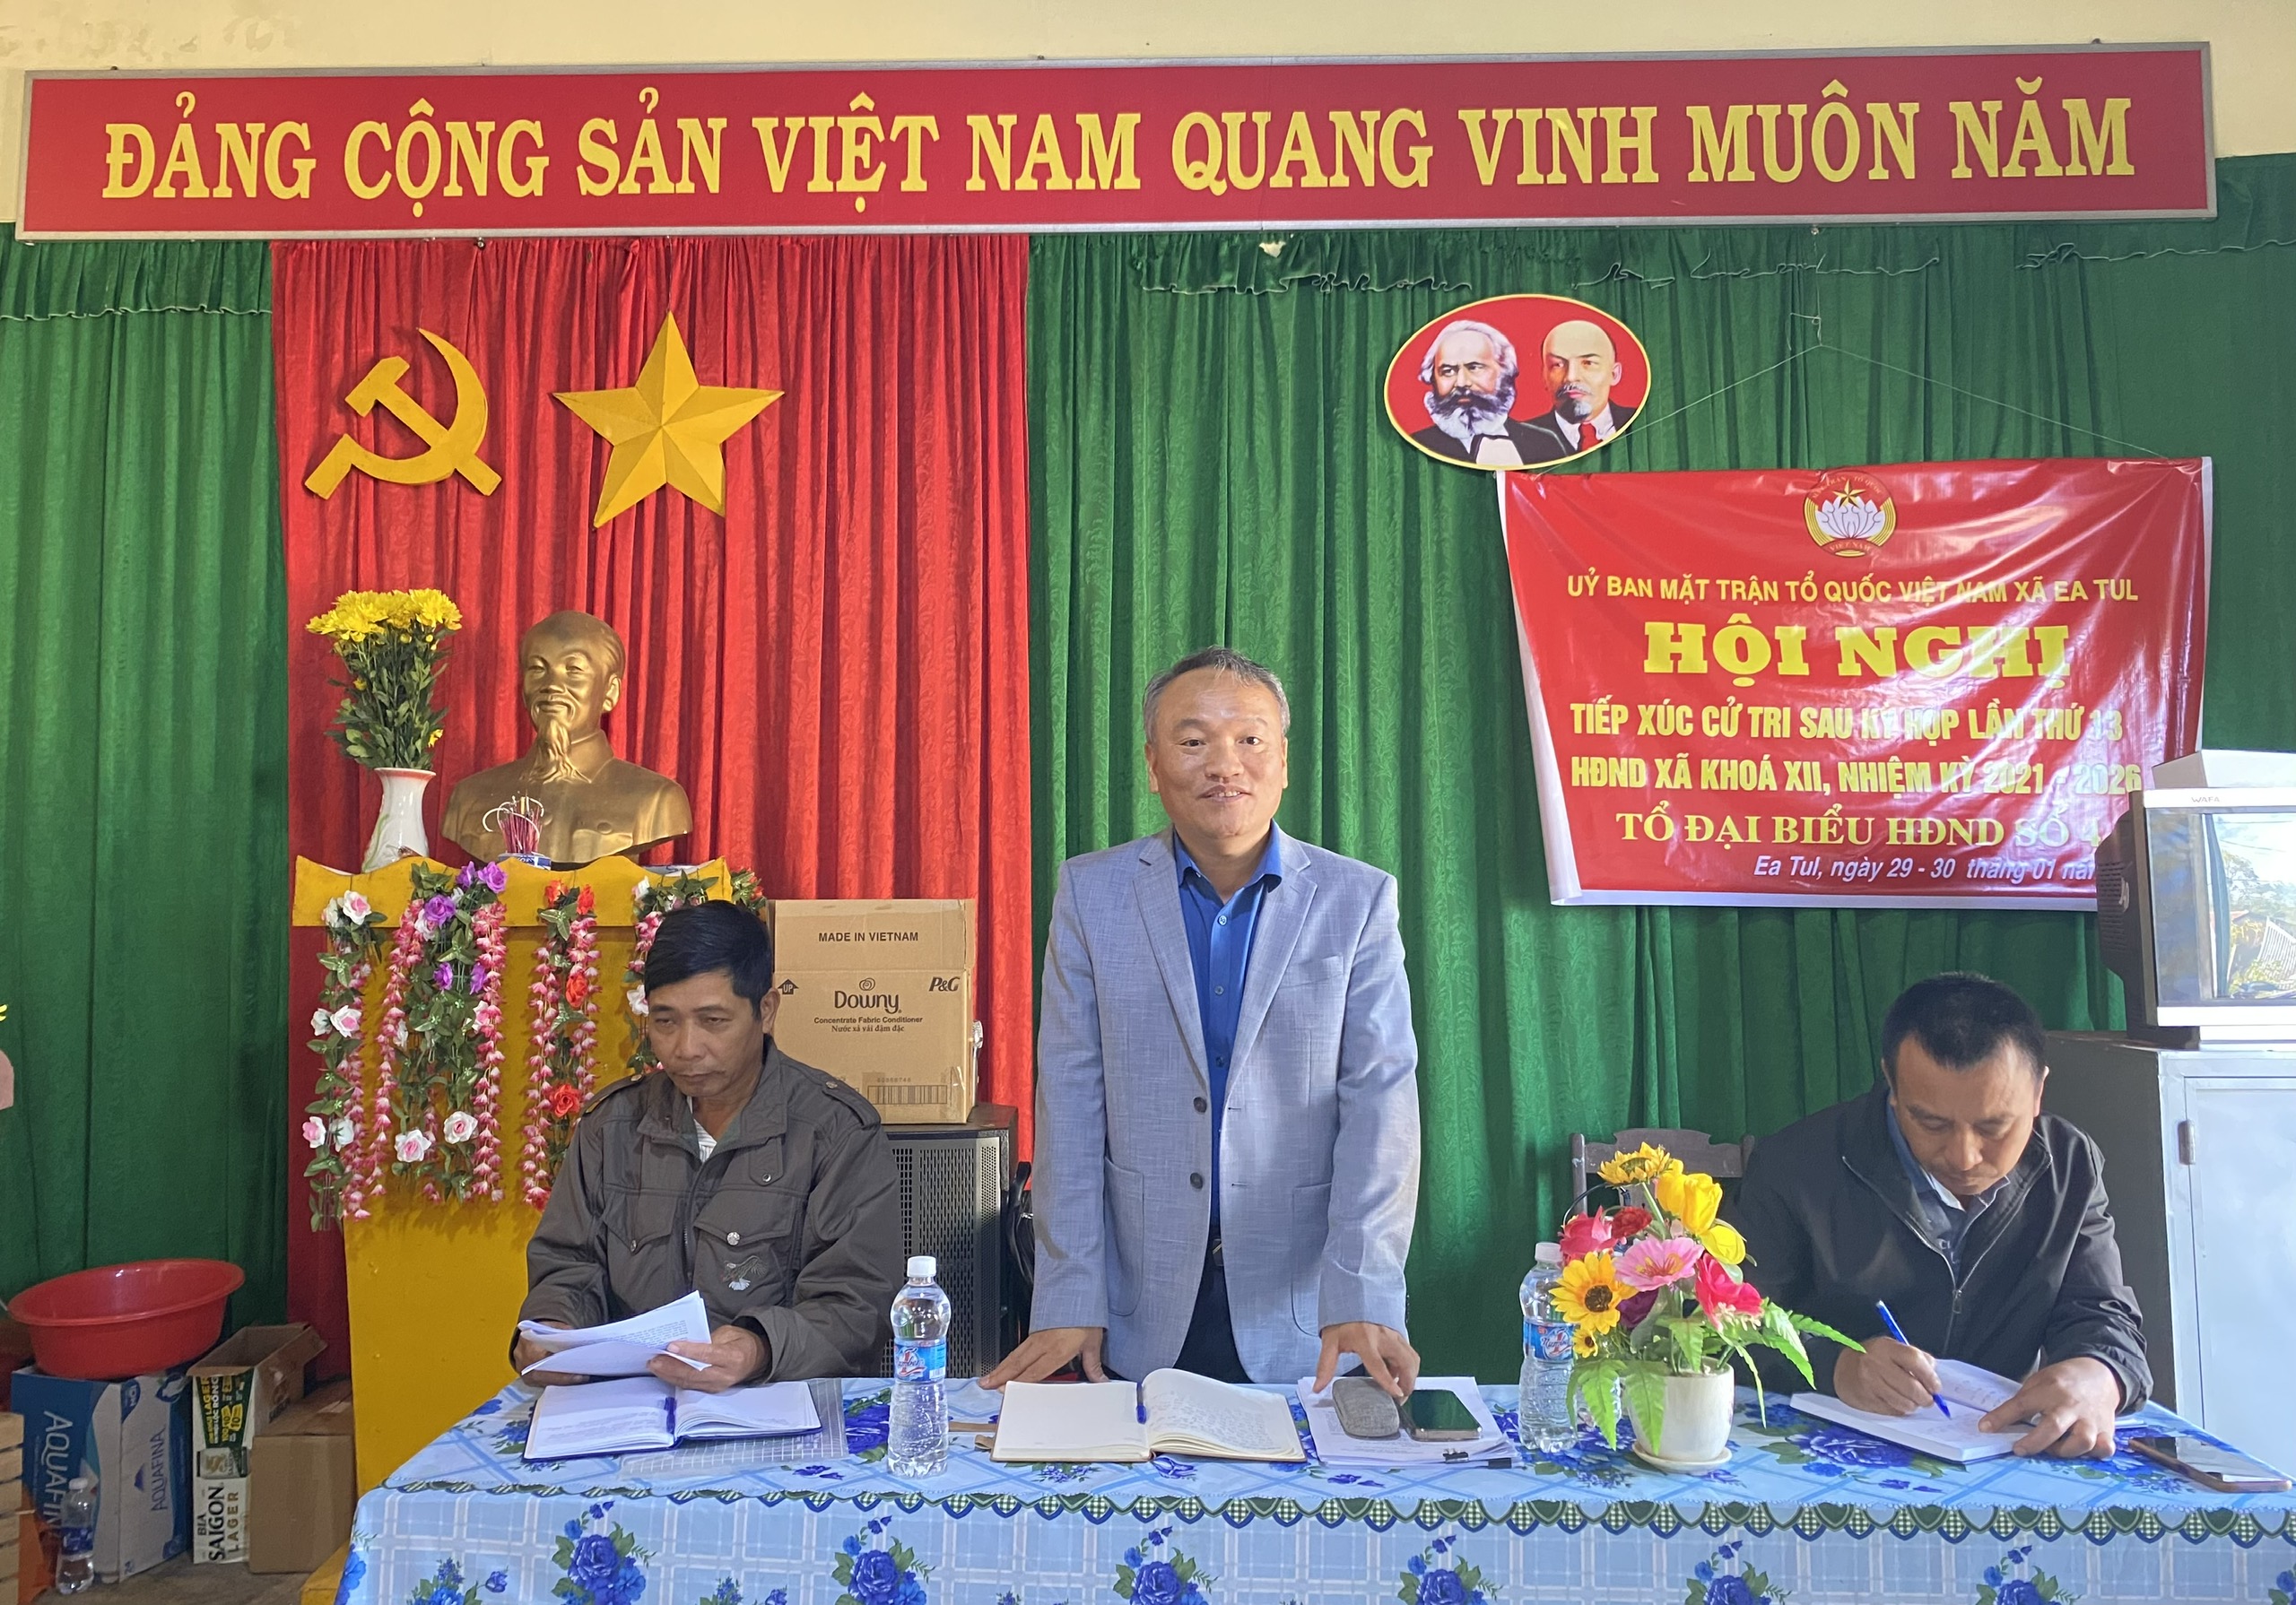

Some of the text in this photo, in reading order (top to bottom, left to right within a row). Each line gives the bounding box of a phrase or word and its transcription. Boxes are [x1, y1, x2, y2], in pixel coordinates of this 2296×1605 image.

[103, 76, 2136, 218] ĐẢNG CỘNG SẢN VIỆT NAM QUANG VINH MUÔN NĂM
[1568, 567, 2139, 606] UỶ BAN MẶT TRẬN TỔ QUỐC VIỆT NAM XÃ EA TUL
[1644, 612, 2071, 689] HỘI NGHỊ
[1570, 694, 1629, 735] TIẾP
[1637, 698, 1693, 736] XÚC
[1702, 696, 1743, 737] CỬ
[1748, 707, 1791, 739] TRI
[1799, 707, 1852, 739] SAU
[1905, 708, 1960, 747] HỌP
[1968, 698, 2027, 741] LẦN
[2031, 702, 2086, 742] THỨ
[2090, 708, 2123, 742] 13
[1571, 756, 1647, 788] HĐND
[1655, 752, 1692, 789] XÃ
[1700, 754, 1778, 791] KHOÁ
[1783, 760, 1831, 796] XII,
[1838, 756, 1933, 799] NHIỆM
[1940, 755, 1975, 794] KỲ
[1983, 763, 2044, 794] 2021
[2073, 764, 2142, 795] 2026
[1616, 800, 1674, 842] TỔ
[1684, 814, 1761, 850] ĐẠI
[1771, 802, 1874, 845] BIỂU
[1885, 818, 2005, 846] HĐND
[2014, 805, 2070, 847] SỐ
[1753, 855, 1781, 876] Ea
[1790, 855, 1822, 879] Tul,
[1831, 855, 1883, 882] ngày
[1887, 858, 1913, 878] 29
[1930, 858, 1956, 879] 30
[1967, 857, 2026, 883] tháng
[2032, 858, 2055, 880] 01
[818, 932, 918, 941] MADE IN VIETNAM
[783, 984, 794, 993] UP
[834, 990, 900, 1014] Downy
[928, 976, 961, 992] P&G
[151, 1426, 169, 1512] AQUAFINA
[197, 1513, 207, 1536] BIA
[207, 1486, 225, 1561] SAIGON
[227, 1492, 239, 1553] LAGER
